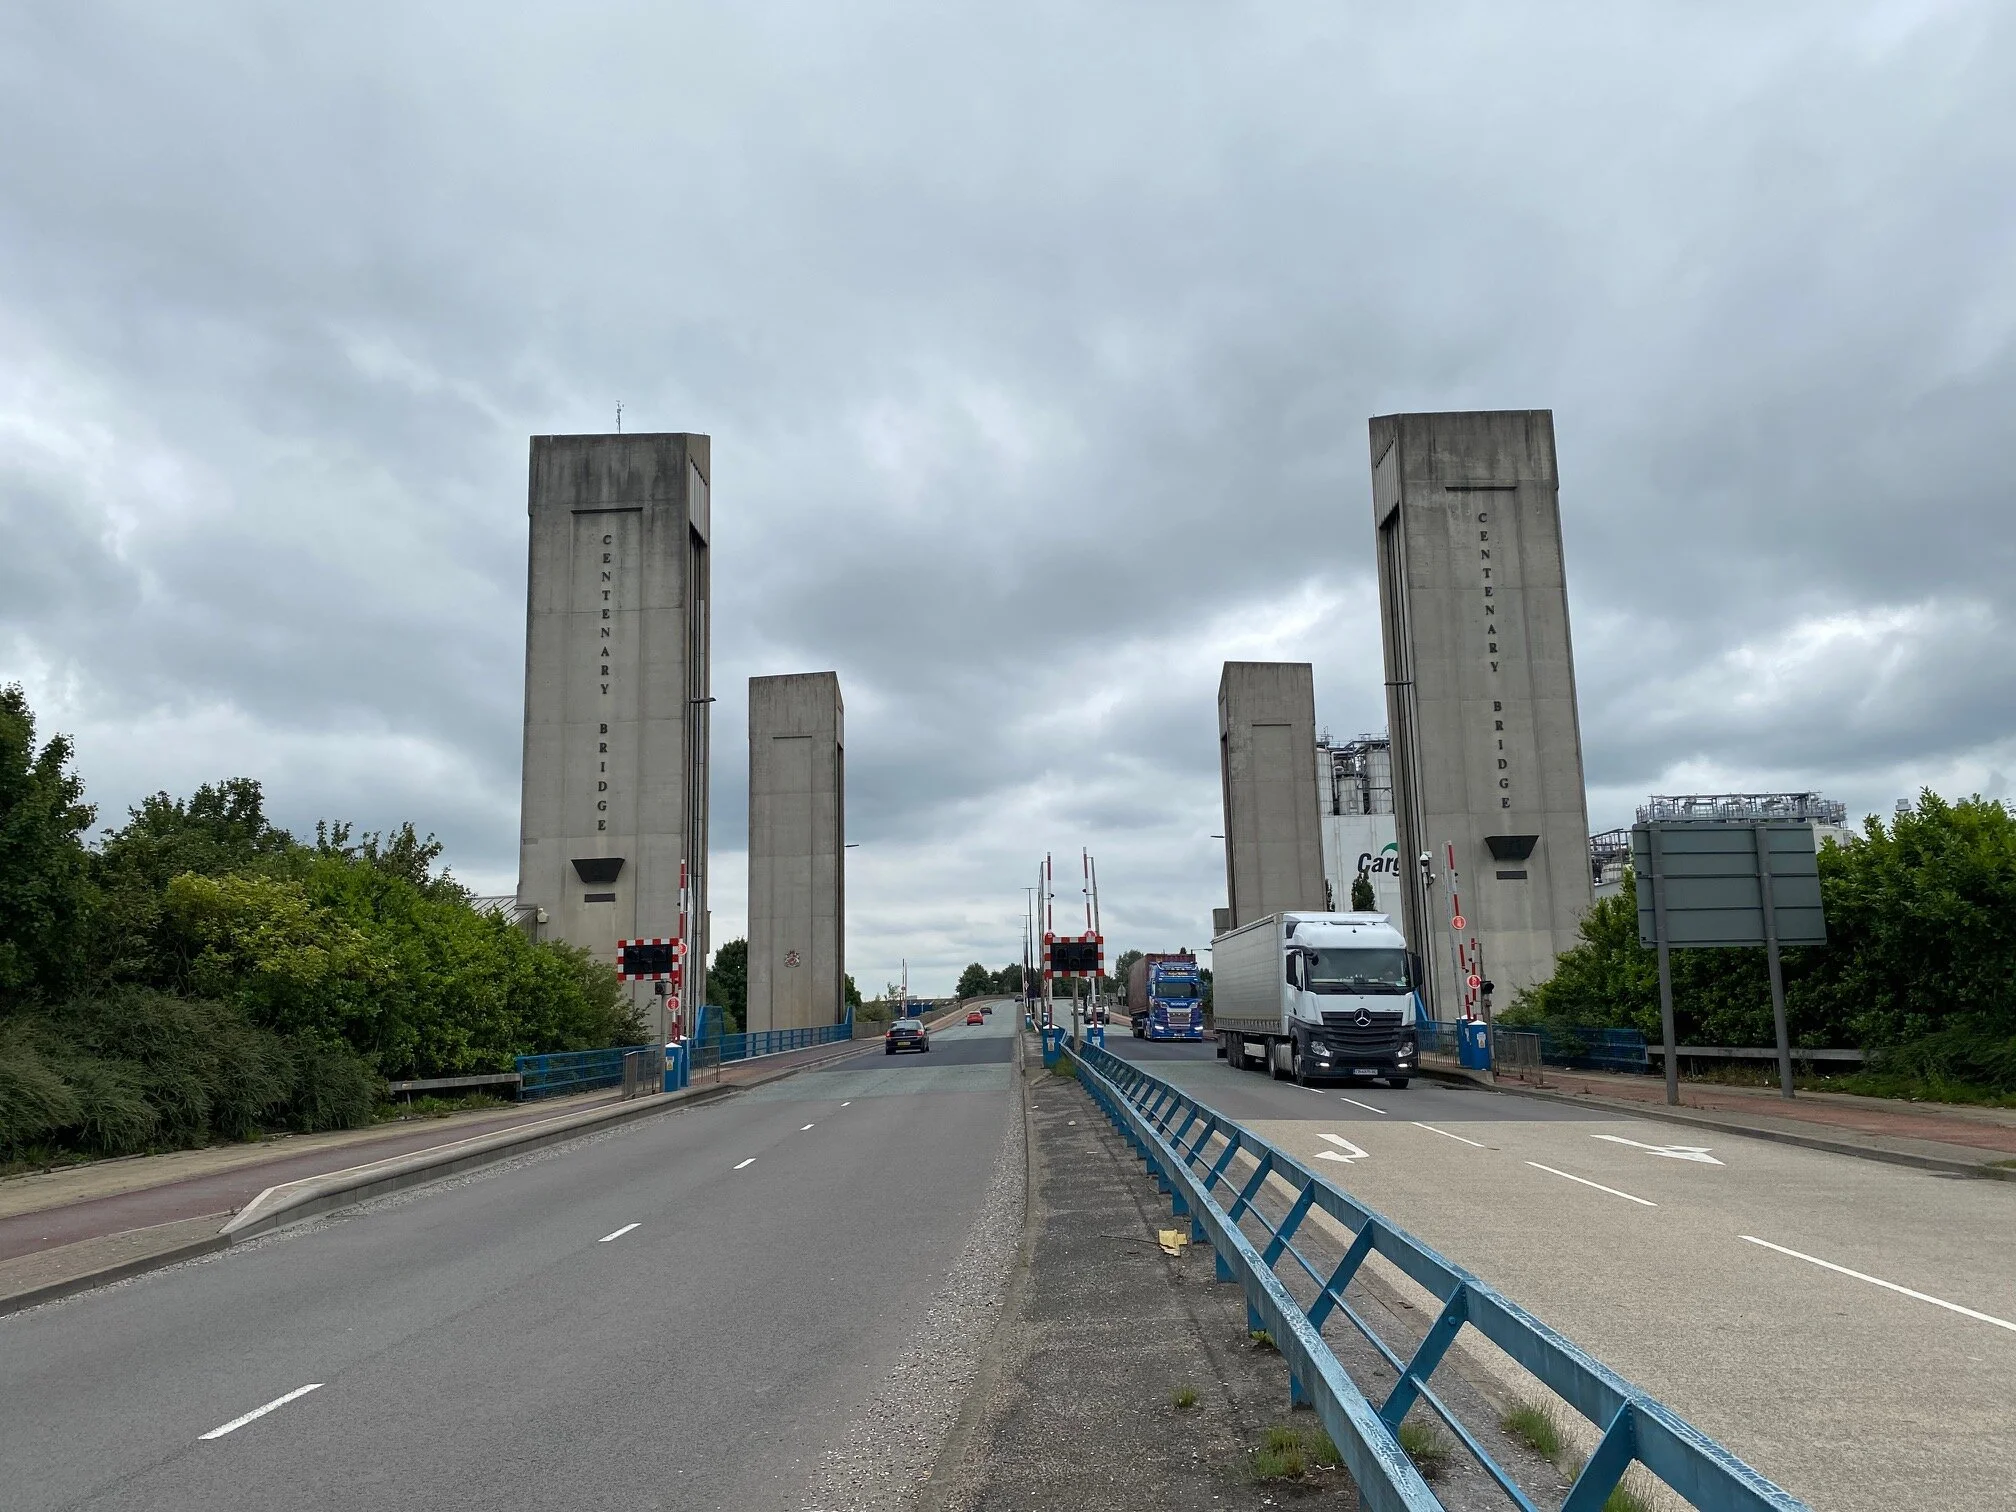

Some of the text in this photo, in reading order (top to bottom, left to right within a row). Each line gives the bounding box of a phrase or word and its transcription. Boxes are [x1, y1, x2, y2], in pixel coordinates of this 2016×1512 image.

[597, 534, 612, 831] CENTENARY BRIDGE
[1478, 512, 1511, 809] CENTENARY BRIDGE
